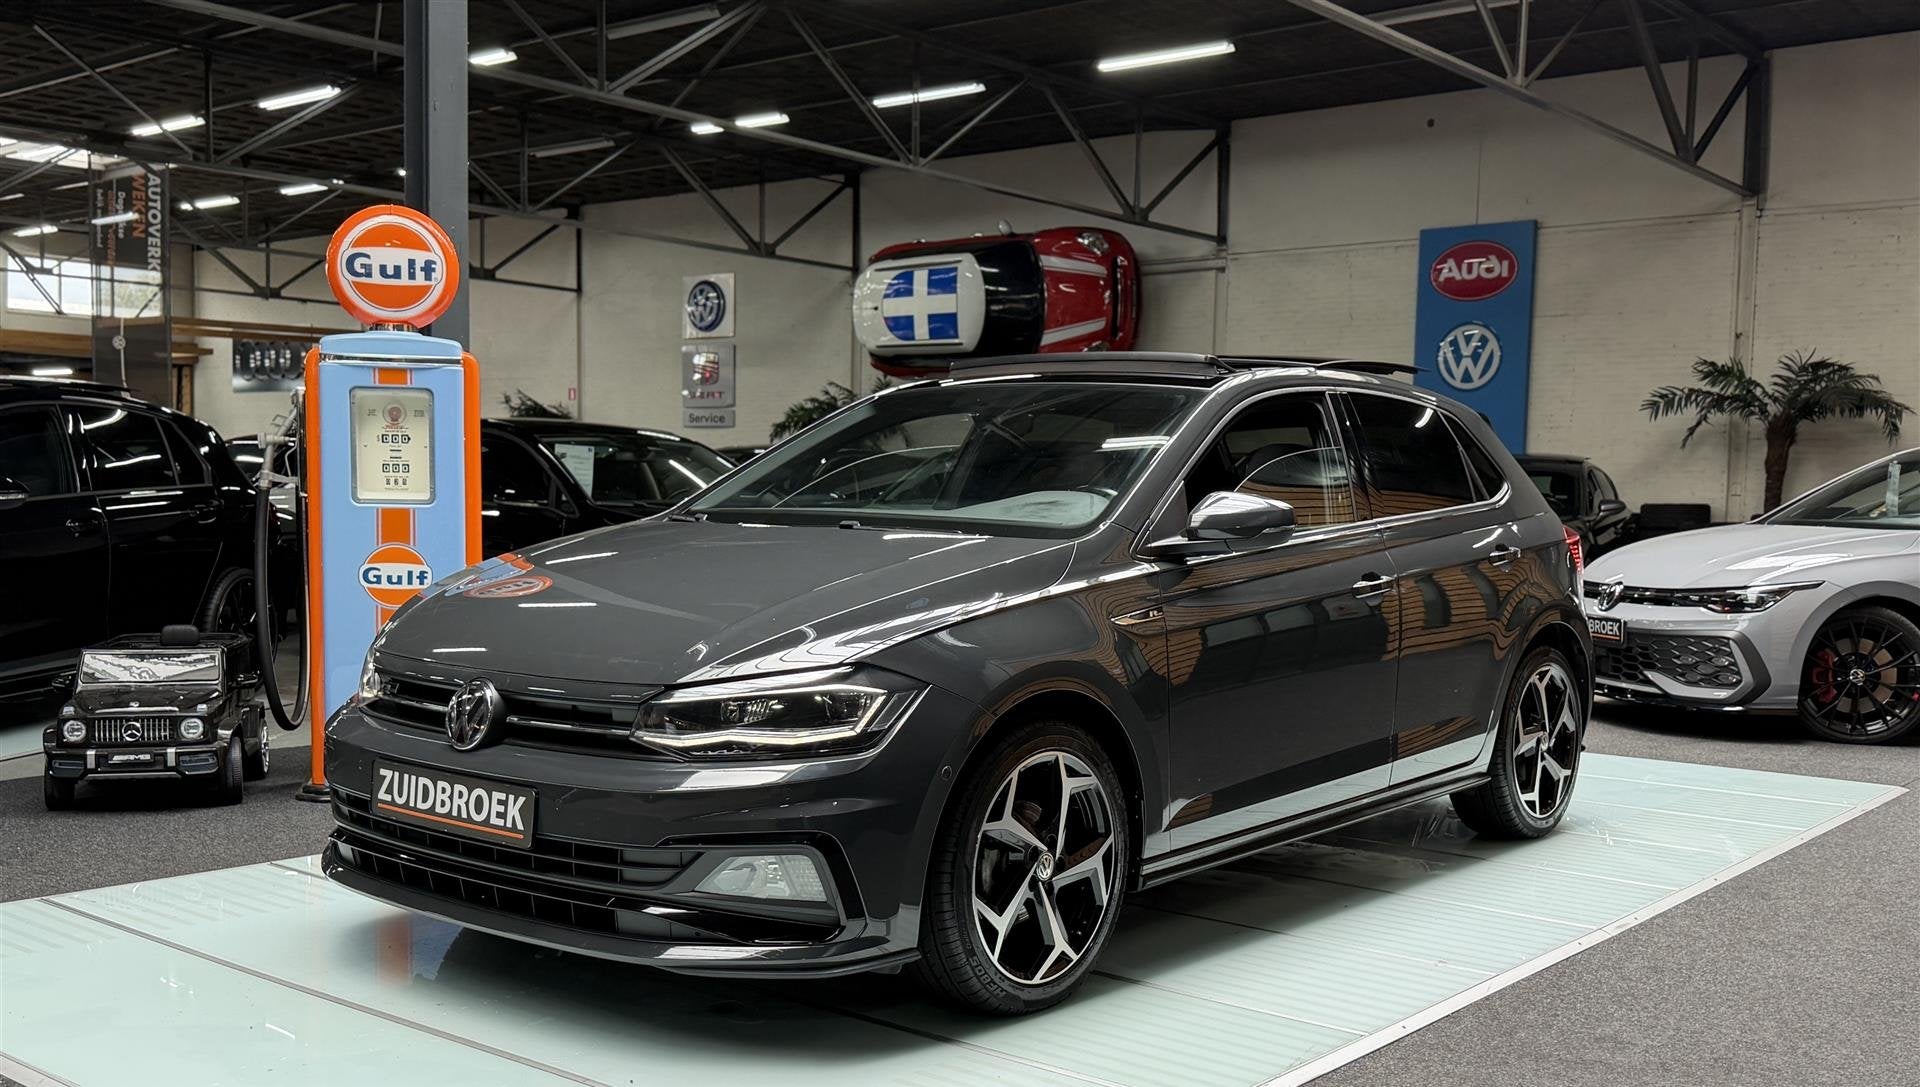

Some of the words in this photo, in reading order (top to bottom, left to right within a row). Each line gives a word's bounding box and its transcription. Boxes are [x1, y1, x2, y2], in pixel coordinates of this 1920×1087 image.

[131, 174, 146, 239] WEKEN
[345, 252, 438, 282] Gulf
[1438, 255, 1510, 282] Audi
[688, 413, 726, 424] Service
[362, 566, 428, 586] Gulf
[1588, 619, 1620, 636] BROEK
[377, 768, 527, 831] ZUIDBROEK
